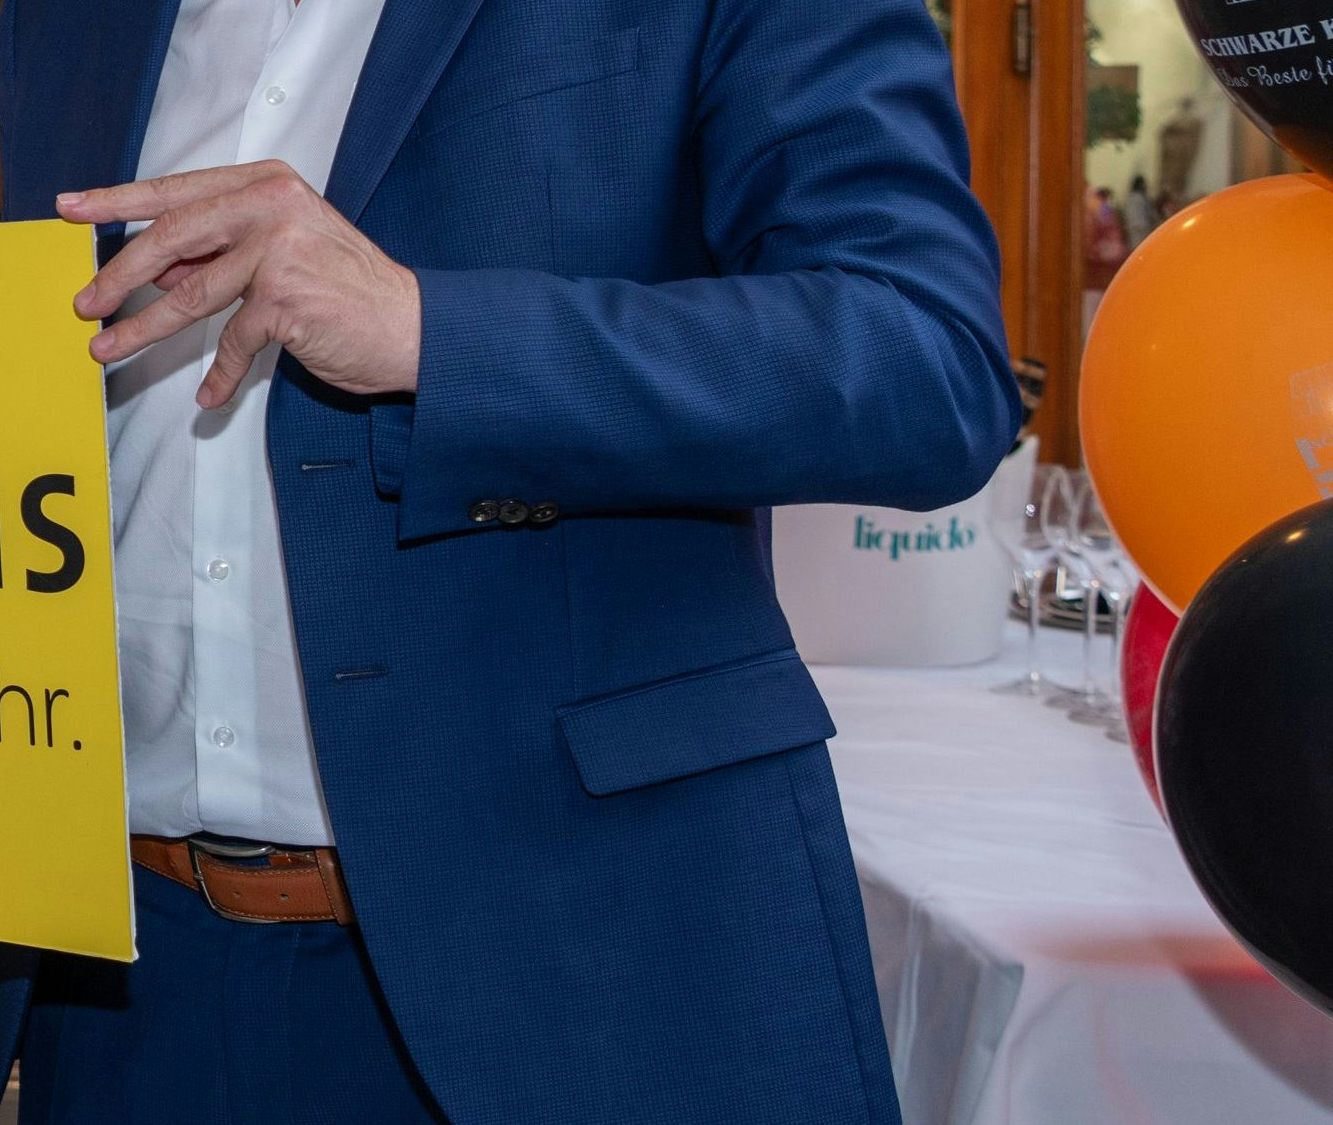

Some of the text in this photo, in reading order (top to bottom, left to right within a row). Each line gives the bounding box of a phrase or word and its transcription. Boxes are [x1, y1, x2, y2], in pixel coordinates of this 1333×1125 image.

[1200, 24, 1316, 57] SCHWARZE
[1247, 65, 1313, 87] Beste
[855, 515, 976, 561] liquido
